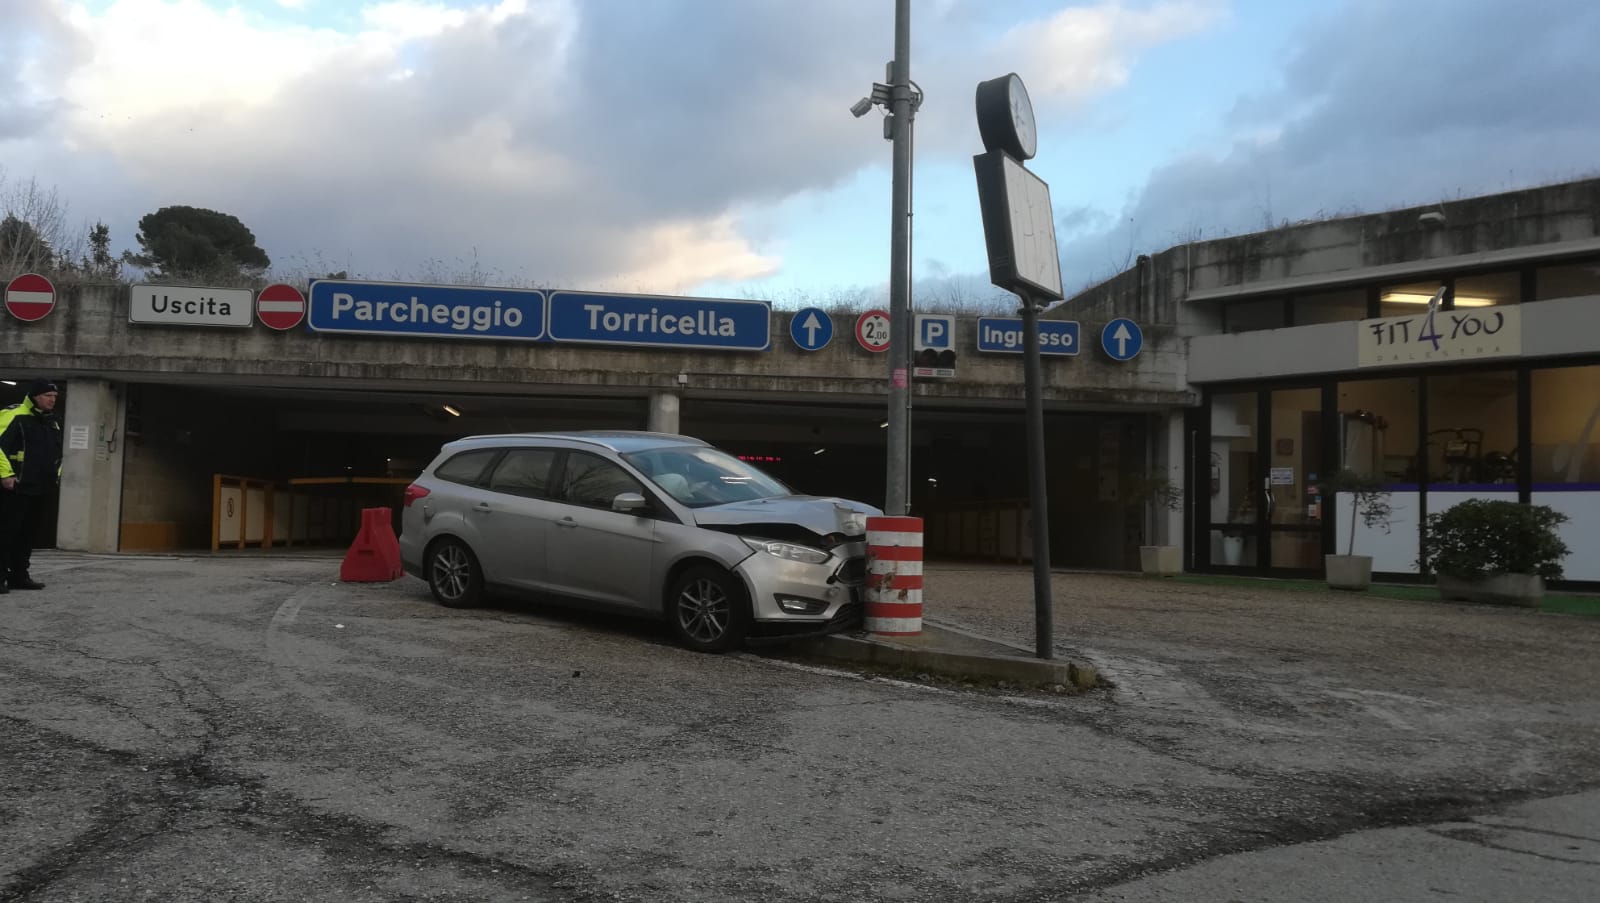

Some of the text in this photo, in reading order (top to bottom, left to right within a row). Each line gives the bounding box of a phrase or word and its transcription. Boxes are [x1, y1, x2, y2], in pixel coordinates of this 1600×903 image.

[151, 294, 232, 316] Uscita
[332, 292, 736, 337] Parcheggio Torricella
[1369, 286, 1504, 352] FIT 4 YOU
[927, 322, 944, 344] P
[984, 325, 1073, 348] Ingrsso
